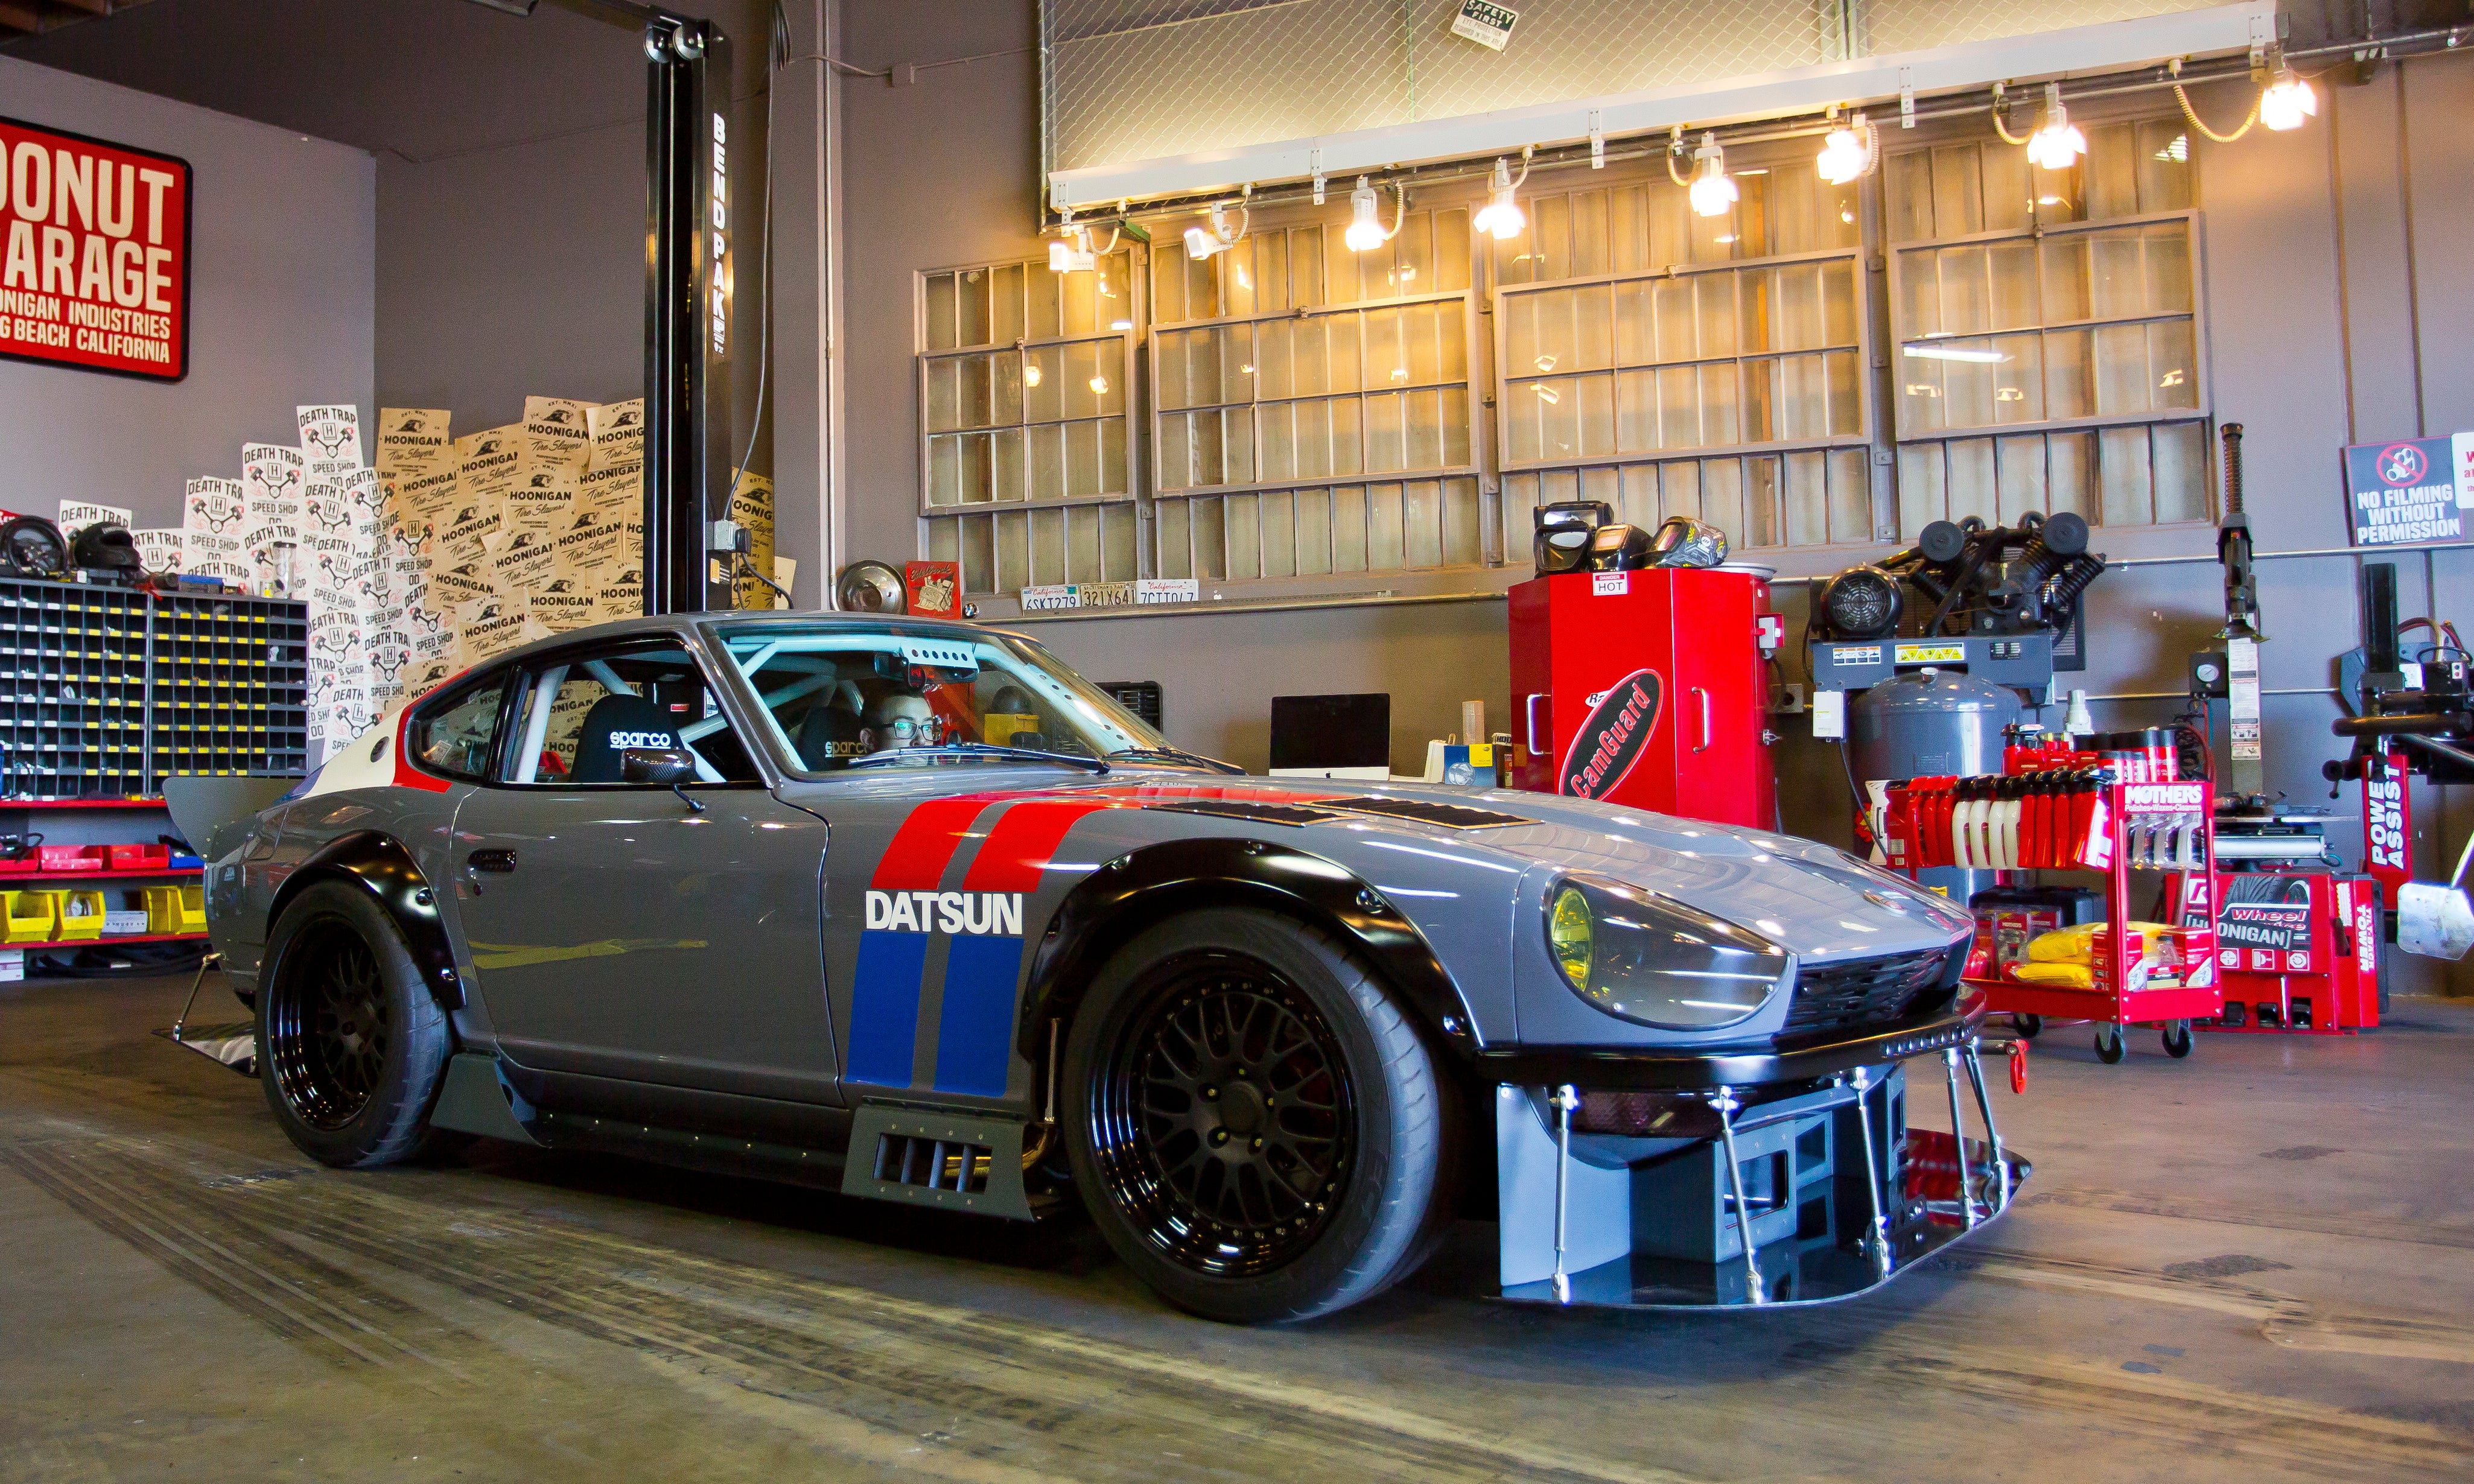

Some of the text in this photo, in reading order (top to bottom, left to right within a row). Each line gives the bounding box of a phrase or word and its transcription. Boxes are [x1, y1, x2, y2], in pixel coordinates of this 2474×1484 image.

[1466, 0, 1515, 24] SAFETY
[1472, 11, 1503, 27] FIRST
[0, 138, 174, 246] ONUT
[713, 113, 725, 320] BENDPAK
[68, 300, 171, 340] INDUSTRIES
[14, 318, 70, 349] BEACH
[76, 328, 170, 364] CALIFORNIA
[300, 408, 356, 427] DEATH TRAP
[384, 435, 442, 446] HOONIGAN
[528, 423, 590, 440] HOONIGAN
[532, 440, 583, 454] Tire Slayers
[244, 448, 304, 468] DEATH TRAP
[313, 462, 356, 474] SPEED SHOP
[188, 480, 221, 495] DEATH
[346, 469, 374, 490] DEATH
[587, 475, 638, 502] Tire Slayers
[305, 485, 337, 498] DEATH
[509, 491, 572, 501] HOONIGAN
[2356, 484, 2453, 510] NO FILMING
[62, 507, 97, 523] DEATH
[252, 503, 298, 514] SPEED SHOP
[2367, 502, 2446, 526] WITHOUT
[360, 524, 381, 536] SPEED
[441, 513, 501, 544] HOONIGAN
[558, 521, 622, 547] HOONIGAN
[2357, 518, 2461, 544] PERMISSION
[133, 532, 154, 547] ATH
[191, 535, 240, 551] SPEED SHOP
[245, 526, 297, 551] DEATH TRA
[317, 539, 349, 553] DEATH
[566, 534, 617, 565] Tire Slayers
[223, 562, 249, 579] TRAP
[353, 560, 380, 580] DEATH
[395, 559, 432, 572] SPEED SHOP
[436, 574, 494, 594] HOONIGAN
[1032, 587, 1069, 598] California
[1148, 581, 1187, 591] California
[1598, 582, 1623, 592] HOT
[314, 588, 336, 603] SPEED
[405, 583, 428, 608] DEATH
[530, 596, 594, 607] HOONIGAN
[366, 608, 402, 625] SPEED SHOP
[465, 613, 526, 639] HOONIGAN
[365, 632, 391, 652] DEATH
[416, 632, 454, 652] SPEED SHOP
[310, 657, 336, 671] TRAP
[346, 665, 364, 675] SHOP
[333, 688, 364, 703] DEATH
[370, 687, 390, 697] SPEED
[610, 731, 672, 749] sparco
[825, 741, 867, 755] sparc
[1571, 682, 1650, 800] CamGuard
[2125, 785, 2202, 804] MOTHERS
[2368, 760, 2388, 865] POWE
[2384, 764, 2405, 870] ASSIST
[866, 890, 1023, 935] DATSUN
[2356, 904, 2370, 972] TOWER
